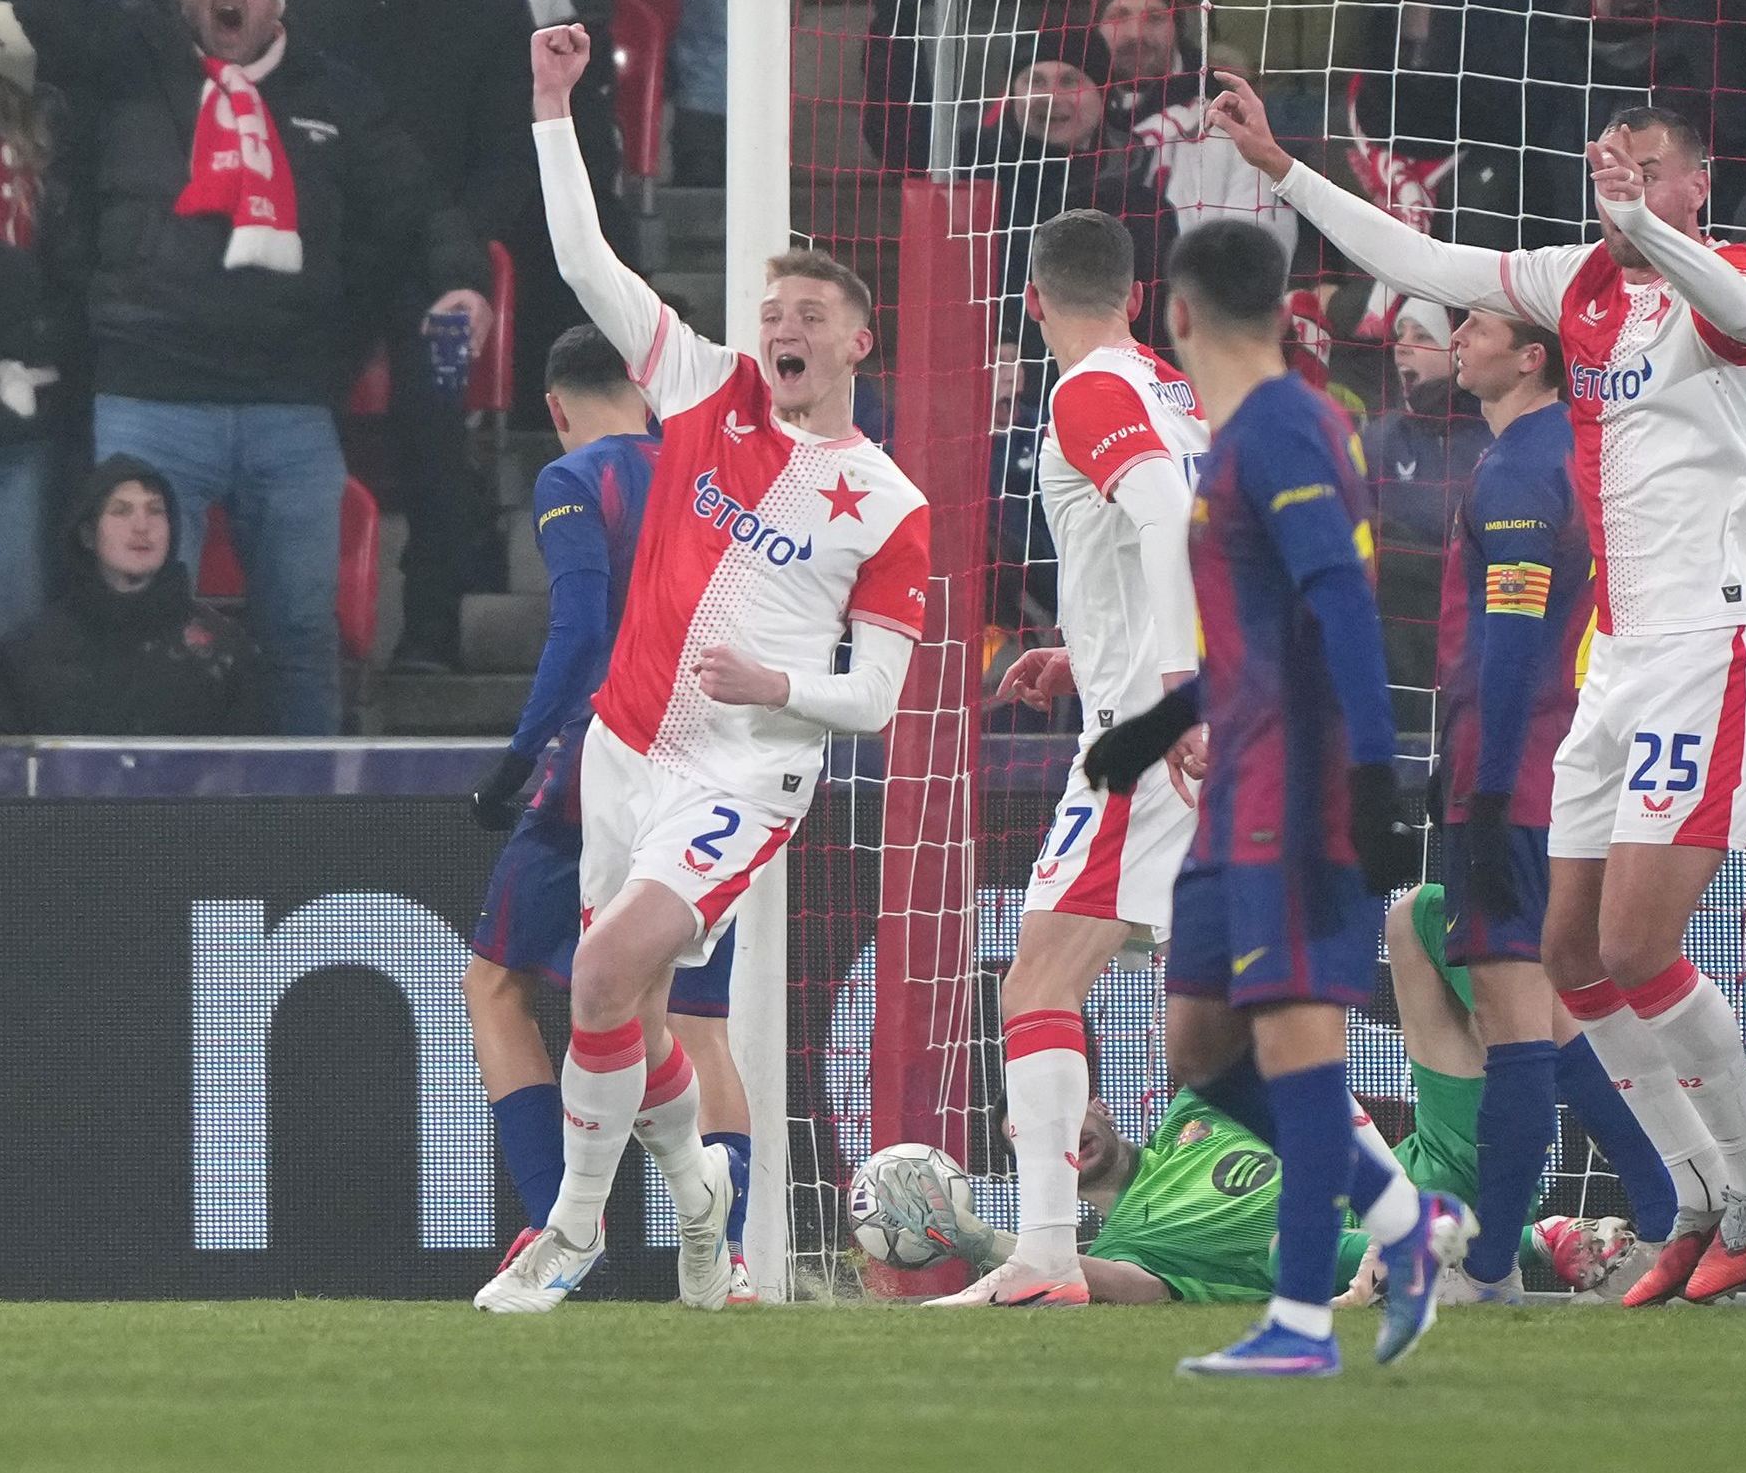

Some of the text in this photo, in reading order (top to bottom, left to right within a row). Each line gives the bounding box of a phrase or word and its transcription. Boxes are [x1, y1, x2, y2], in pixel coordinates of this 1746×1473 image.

[1091, 422, 1148, 461] FORTUNA
[1485, 519, 1536, 532] AMBILIGHT
[1628, 731, 1702, 792] 25
[691, 805, 741, 862] 2
[1038, 806, 1093, 865] 7
